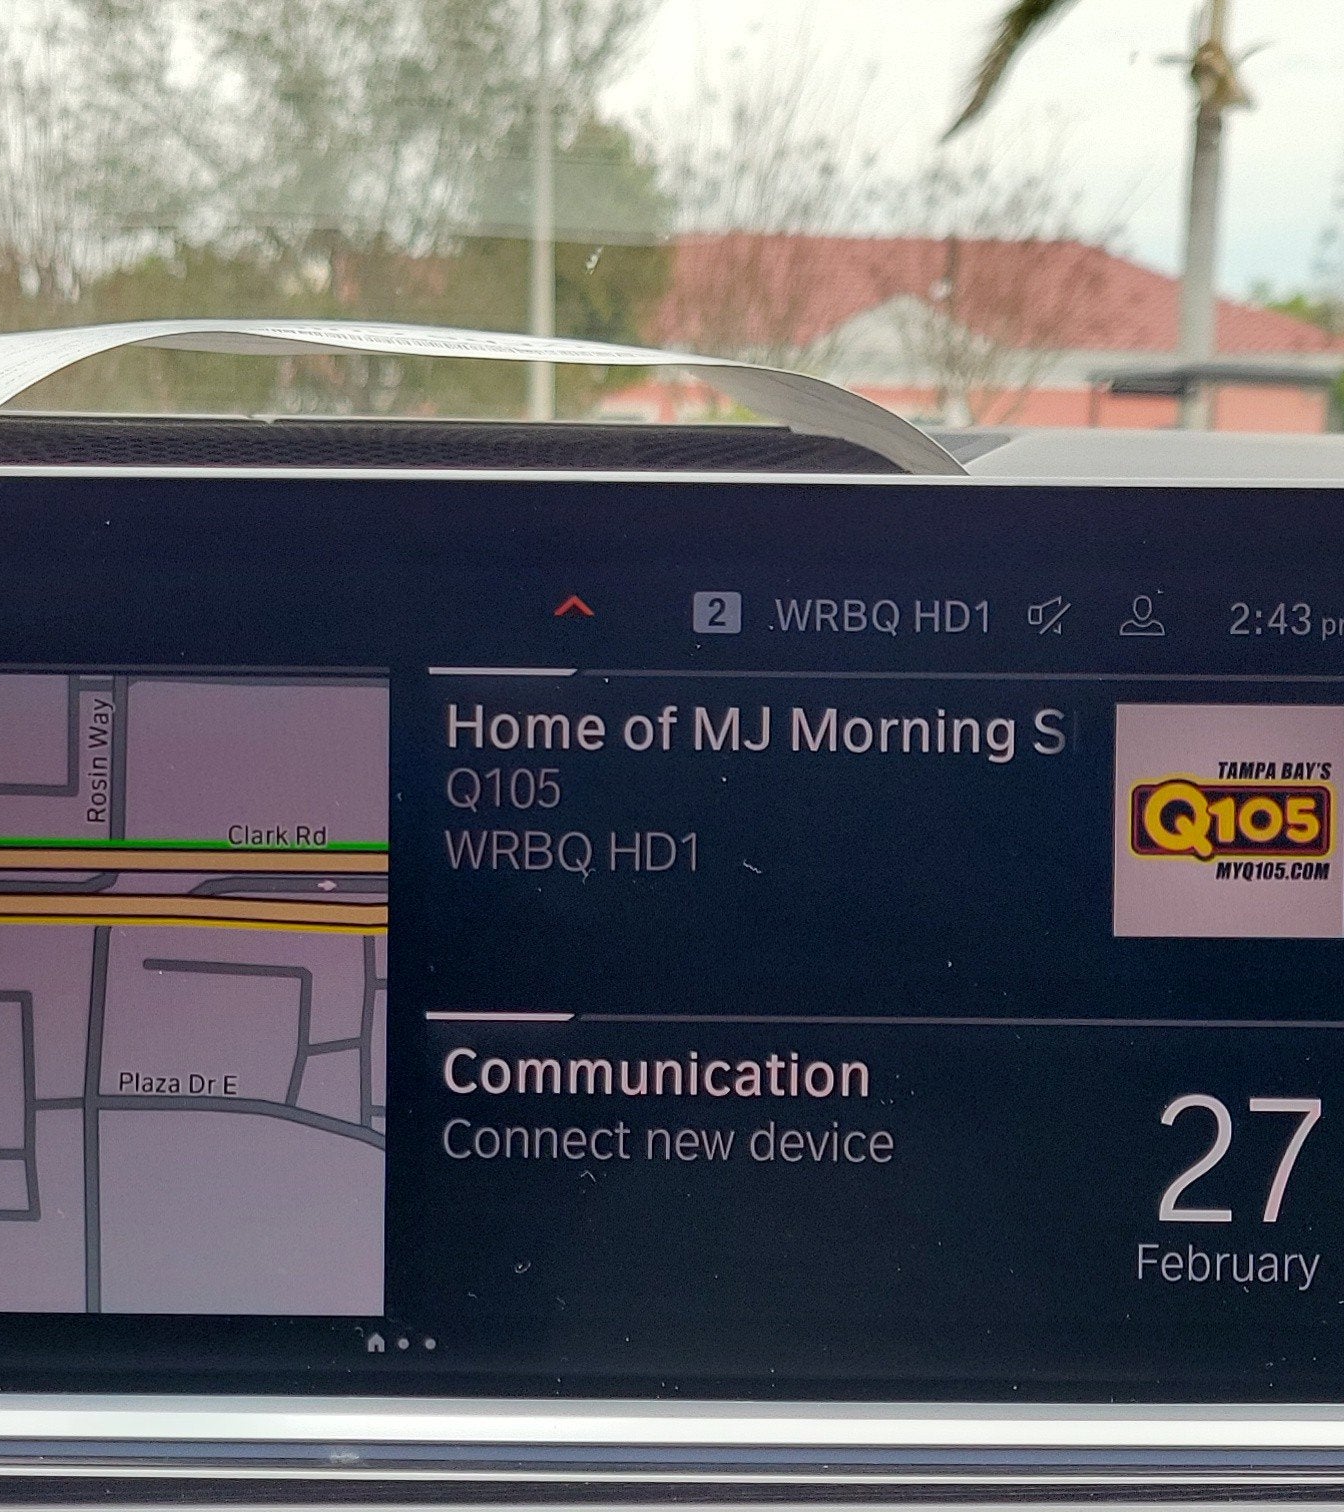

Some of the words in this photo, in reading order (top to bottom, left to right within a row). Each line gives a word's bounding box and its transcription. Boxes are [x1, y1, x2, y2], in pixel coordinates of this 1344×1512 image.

[707, 599, 726, 626] 2
[775, 599, 899, 636] WRBQ
[915, 600, 987, 632] HD1
[1230, 602, 1311, 635] 2:43
[88, 699, 115, 749] Way
[449, 704, 605, 750] Home
[624, 706, 677, 750] of
[695, 707, 770, 750] MJ
[792, 708, 1014, 762] Morning
[87, 757, 107, 823] Rosin
[447, 768, 560, 812] Q105
[1219, 762, 1275, 779] TAMPA
[1281, 762, 1331, 780] BAY'S
[229, 825, 287, 845] Clark
[297, 826, 325, 845] Rd
[1144, 782, 1323, 858] Q105
[445, 830, 593, 877] WRBQ
[611, 832, 696, 871] HD1
[1216, 862, 1330, 881] MYQ105.COM
[118, 1071, 181, 1094] Plaza
[189, 1073, 219, 1095] Dr
[223, 1075, 238, 1095] E
[444, 1048, 868, 1097] Communication
[443, 1119, 630, 1160] Connect
[647, 1129, 734, 1160] new
[750, 1121, 893, 1162] device
[1159, 1094, 1321, 1222] 27
[1138, 1244, 1320, 1290] February
